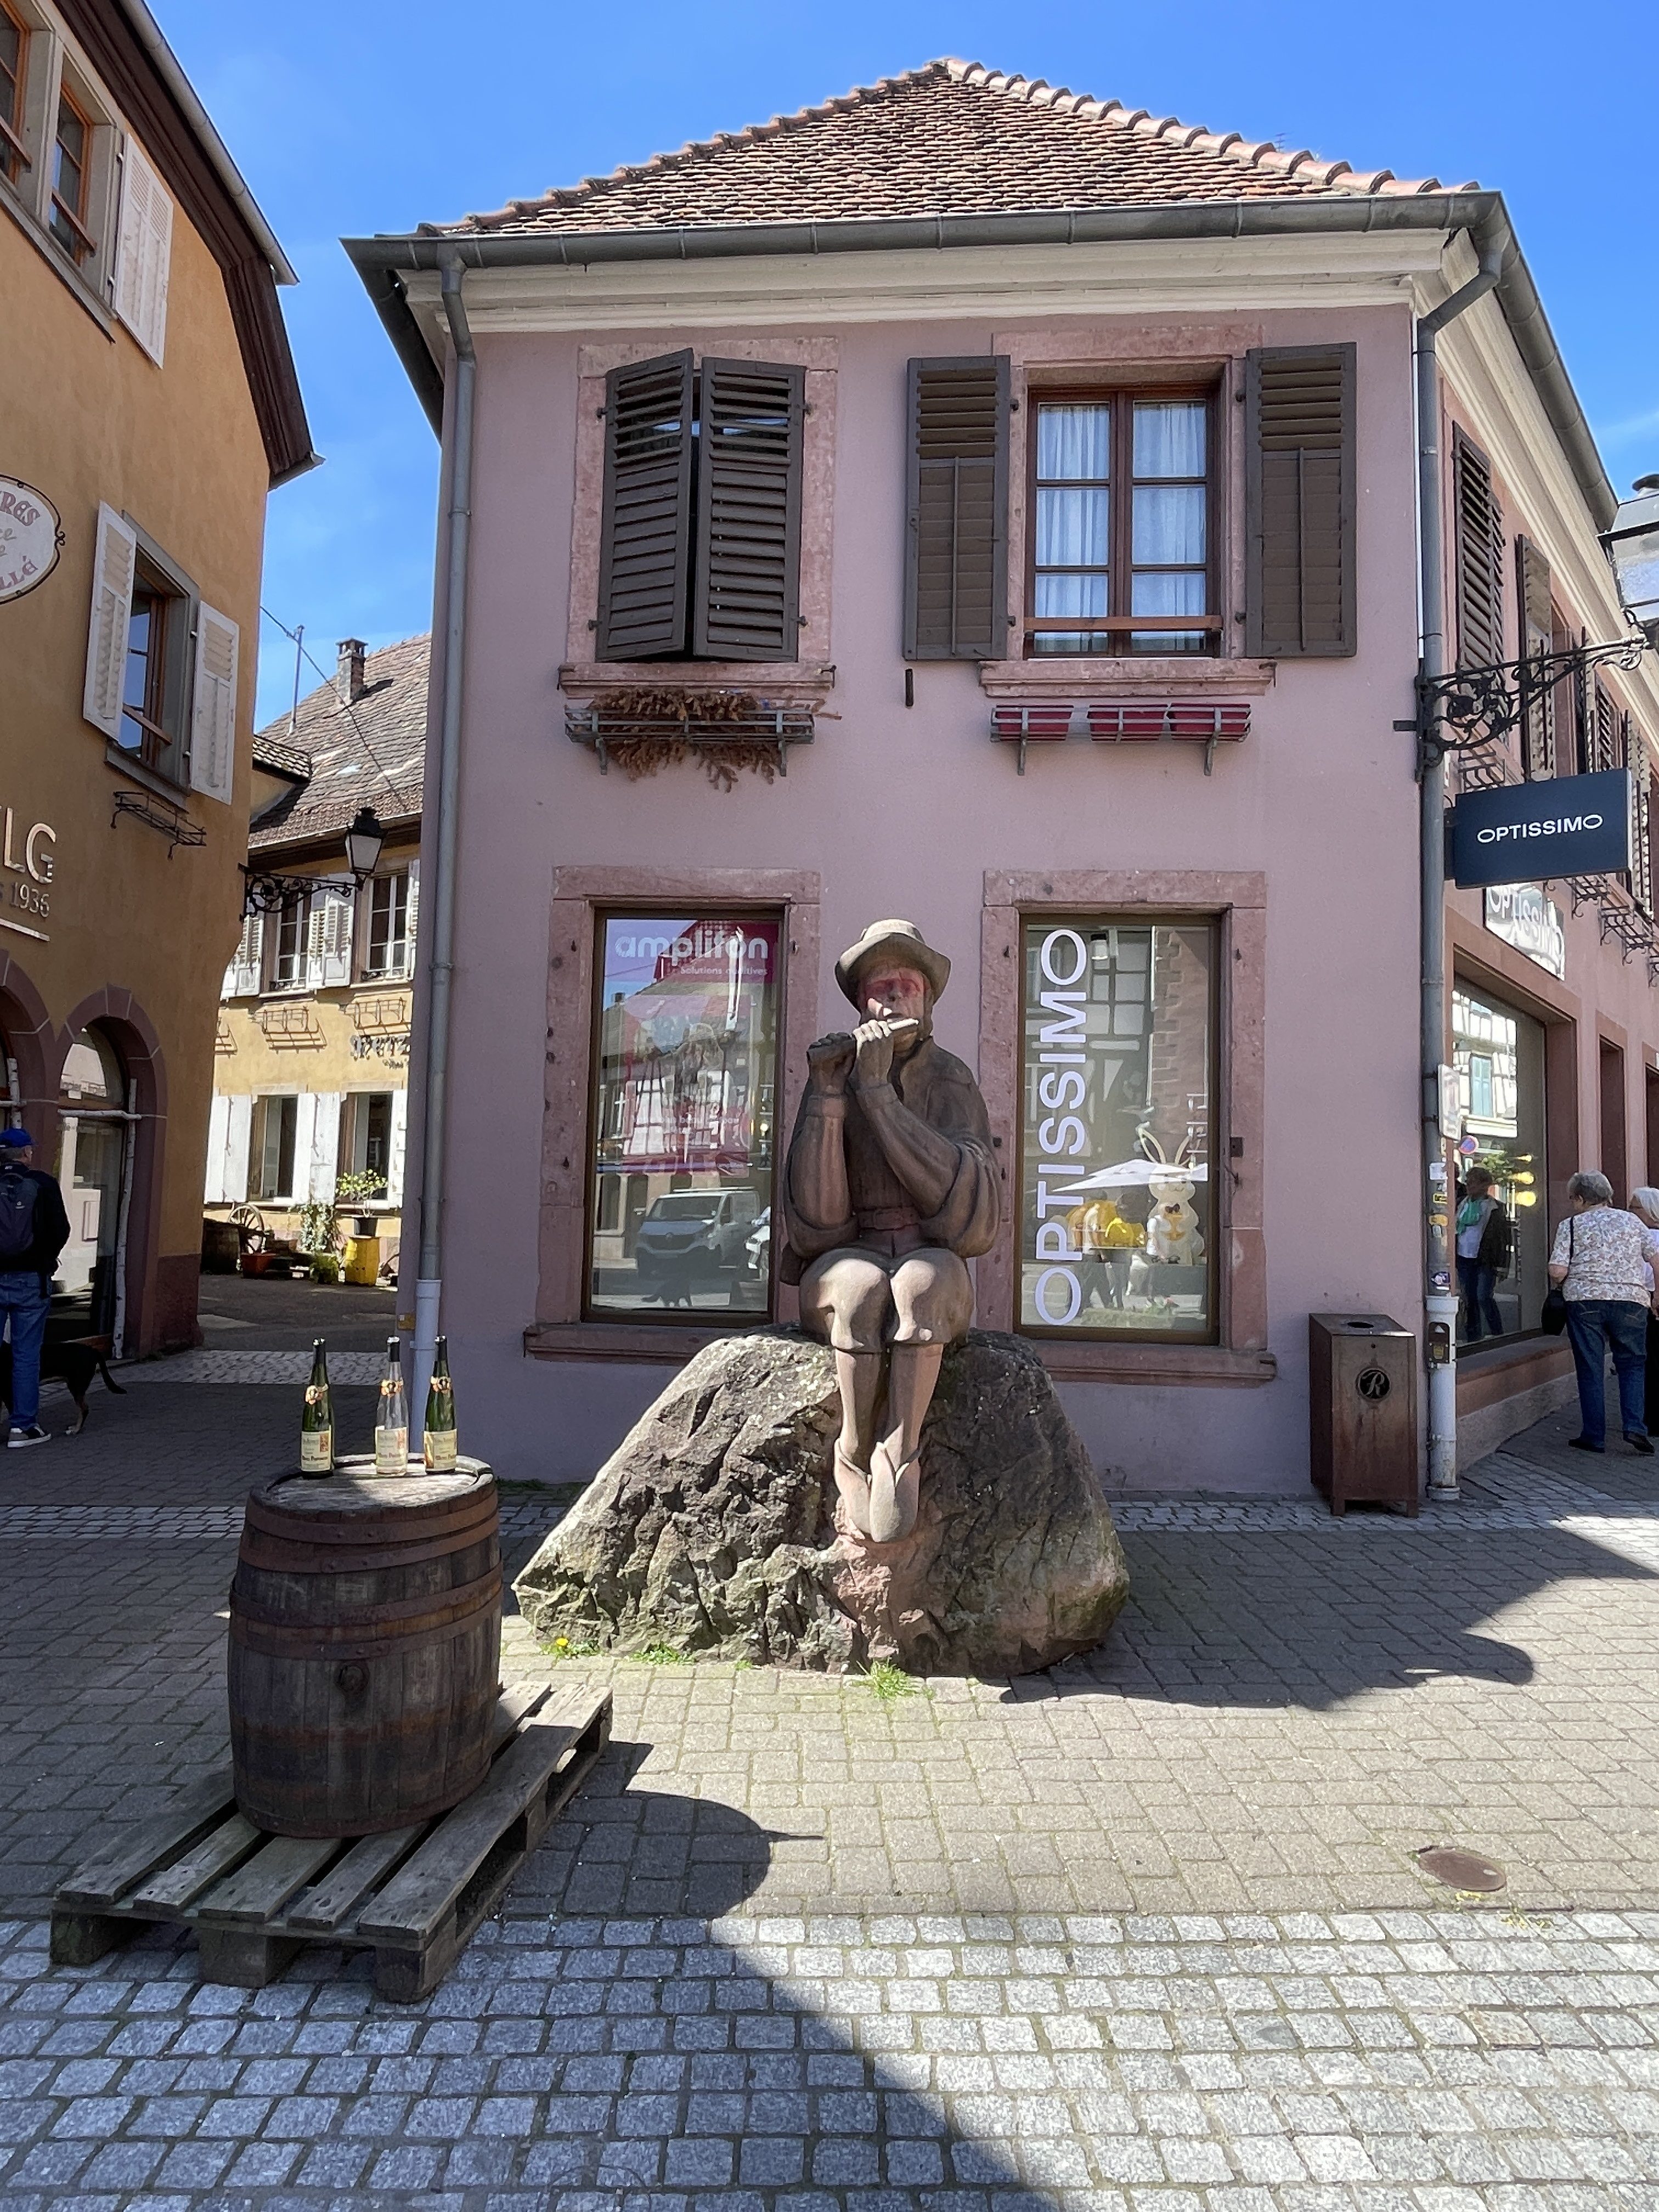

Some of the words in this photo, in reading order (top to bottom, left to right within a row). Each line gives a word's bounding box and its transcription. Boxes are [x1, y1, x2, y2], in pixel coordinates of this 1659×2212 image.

[0, 805, 56, 885] LG
[1477, 814, 1603, 843] OPTISSIMO
[10, 882, 50, 917] 1936
[614, 929, 768, 967] amplifon
[680, 966, 723, 975] Solutions
[725, 967, 768, 975] aditives
[1035, 929, 1087, 1325] OPTISSIMO
